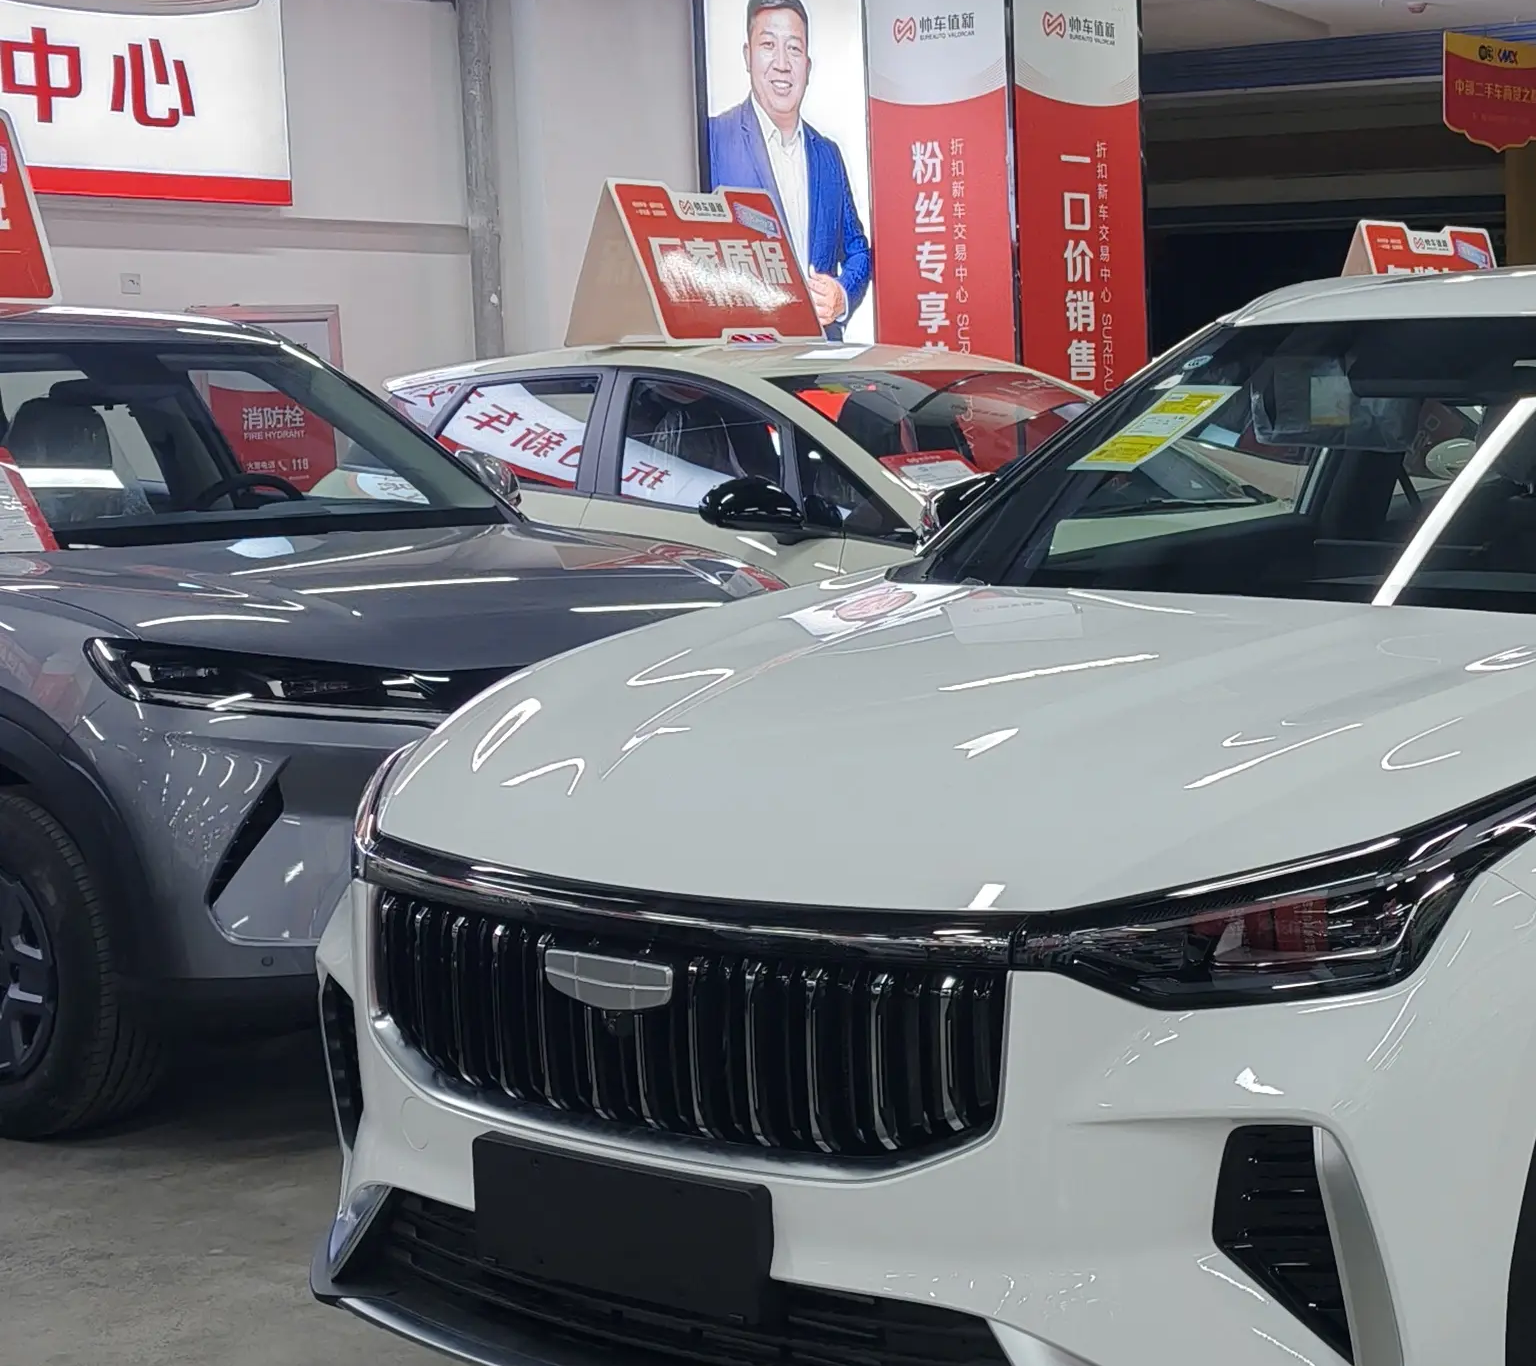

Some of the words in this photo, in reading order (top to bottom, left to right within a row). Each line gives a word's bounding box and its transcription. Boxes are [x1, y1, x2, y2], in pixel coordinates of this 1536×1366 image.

[919, 12, 975, 33] 帅车值新
[0, 26, 195, 128] 中心
[950, 138, 969, 304] 折扣新车交易中心
[1060, 154, 1097, 382] 一口价销售
[1095, 140, 1112, 304] 折扣新车交易中心
[242, 405, 306, 430] 消防栓
[243, 431, 263, 440] FIRE
[264, 429, 305, 439] HYDRANT
